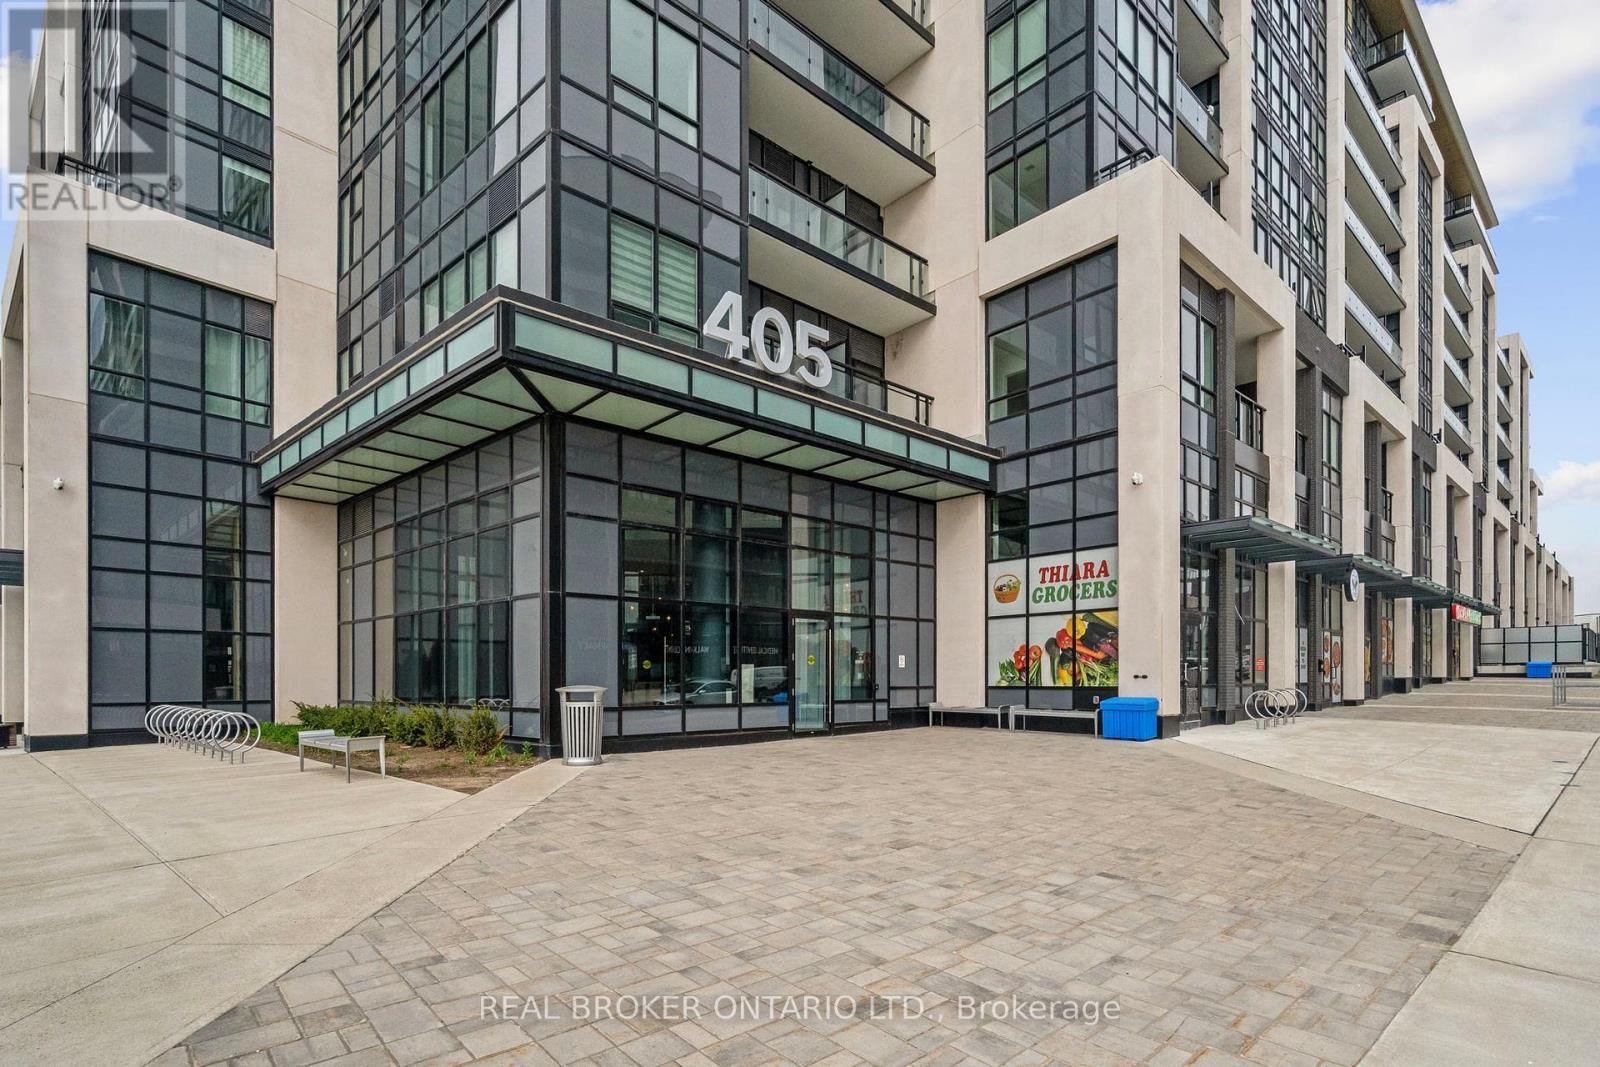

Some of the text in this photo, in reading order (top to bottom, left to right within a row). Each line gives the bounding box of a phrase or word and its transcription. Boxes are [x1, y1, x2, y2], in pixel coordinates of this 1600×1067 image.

[703, 291, 833, 388] 405
[1039, 560, 1110, 584] THIARA
[1032, 579, 1118, 604] GROCERS
